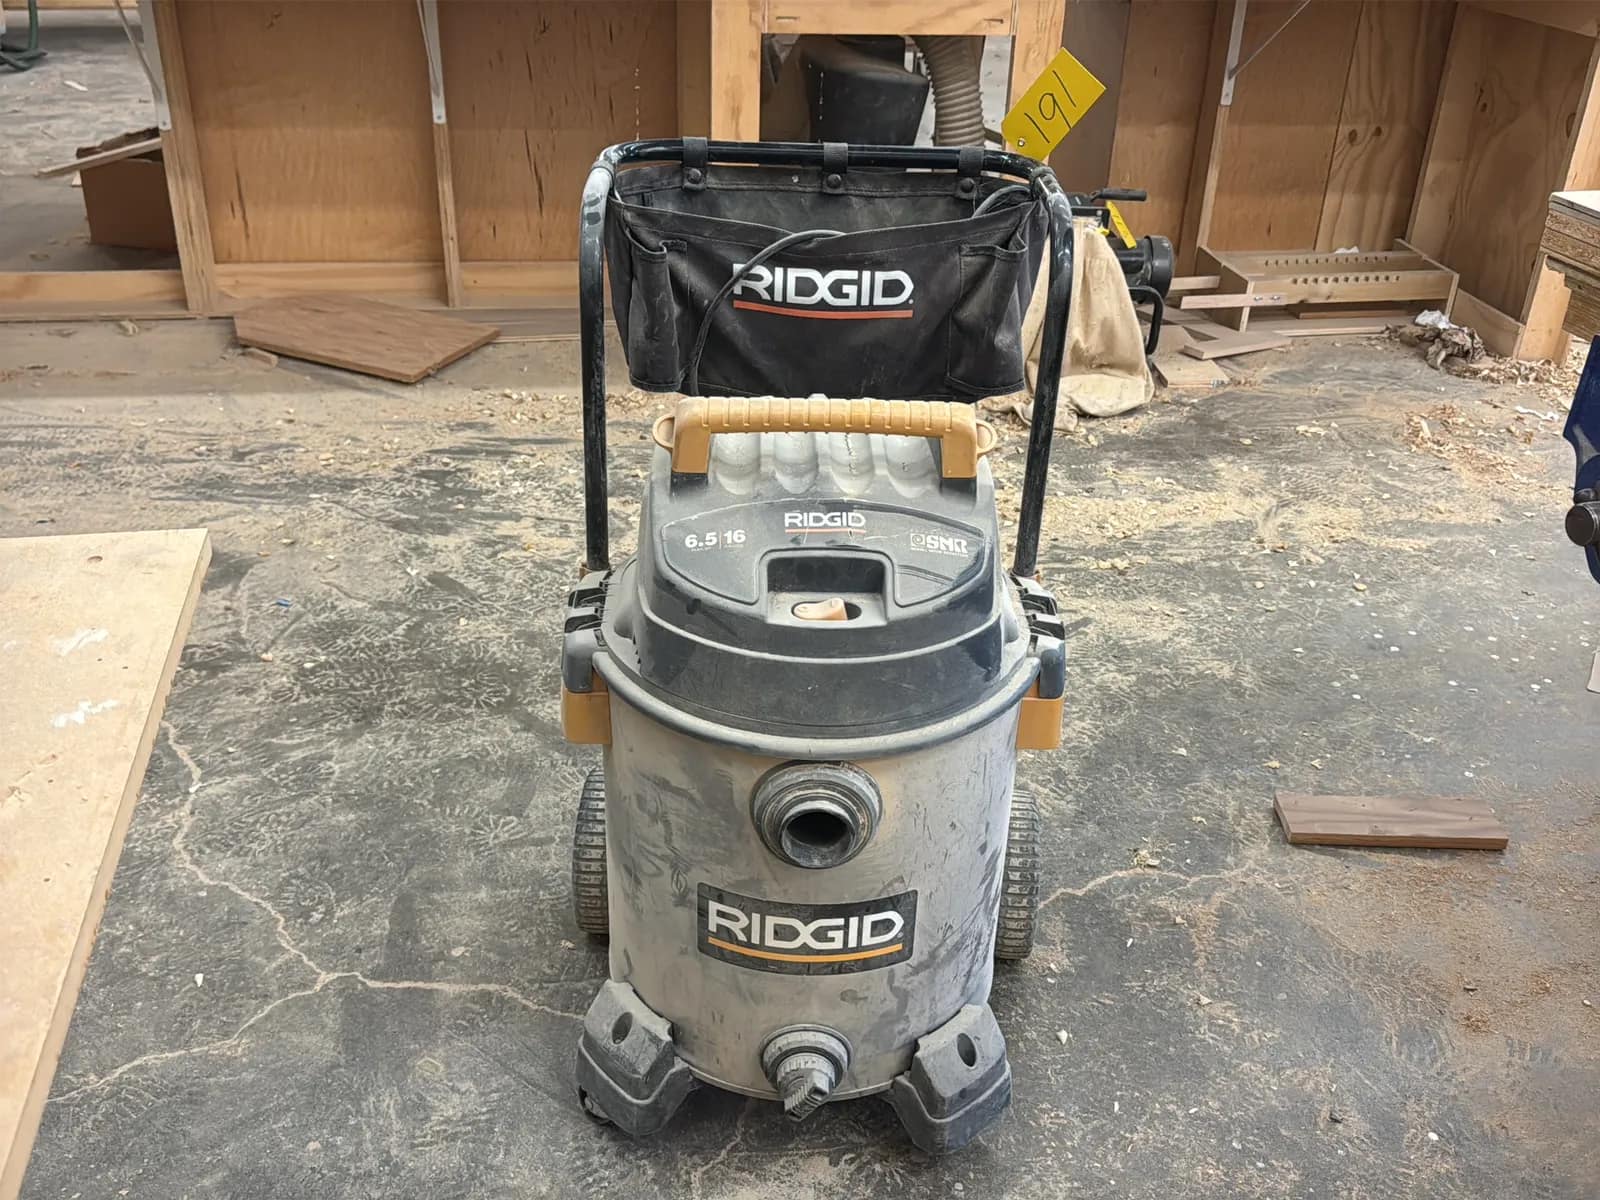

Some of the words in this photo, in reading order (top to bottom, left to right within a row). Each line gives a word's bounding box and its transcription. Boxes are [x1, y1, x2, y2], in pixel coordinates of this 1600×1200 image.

[1023, 69, 1077, 144] 191
[732, 263, 914, 307] RIDGID
[684, 531, 718, 548] 6.5
[723, 529, 746, 544] 16
[784, 511, 866, 528] RIDGID
[707, 899, 905, 951] RIDGID
